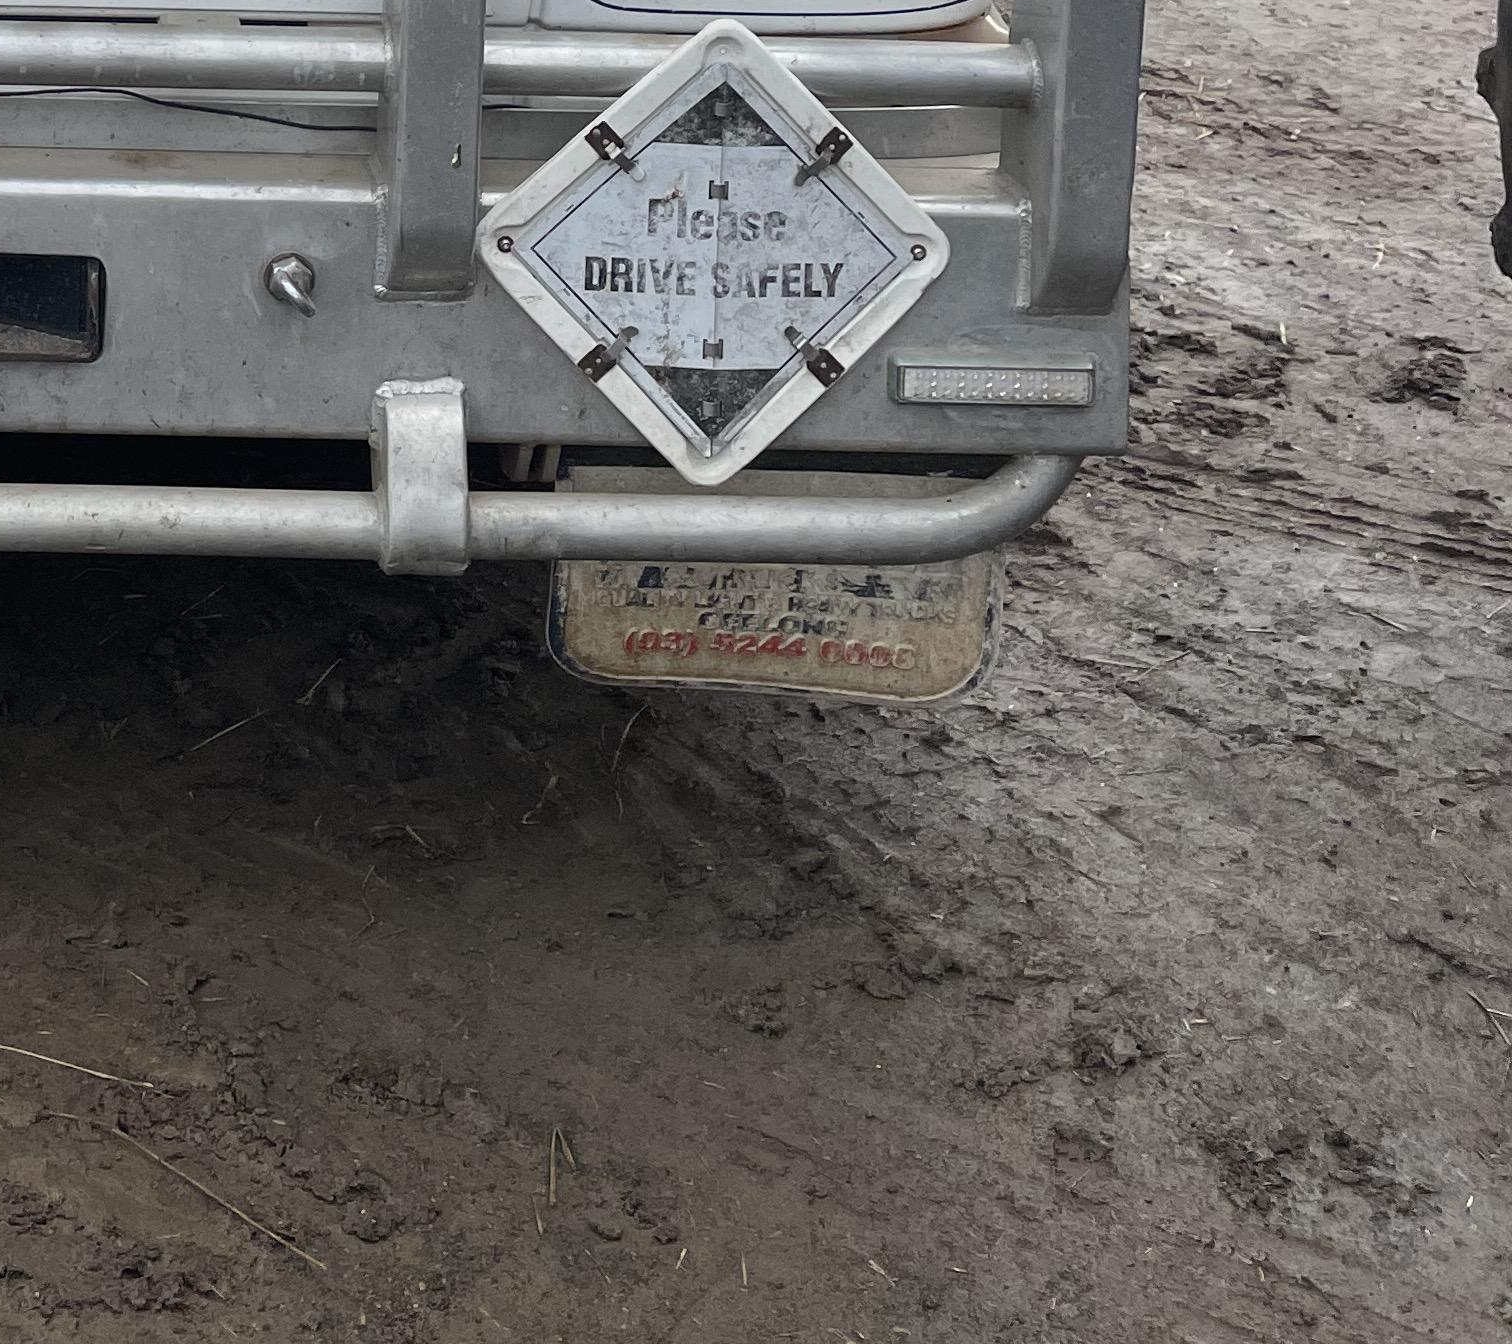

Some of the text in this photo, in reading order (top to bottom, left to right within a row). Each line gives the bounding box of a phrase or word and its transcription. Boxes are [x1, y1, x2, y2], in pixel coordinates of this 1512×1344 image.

[647, 197, 788, 242] Please
[584, 255, 844, 300] DRIVE SAFELY
